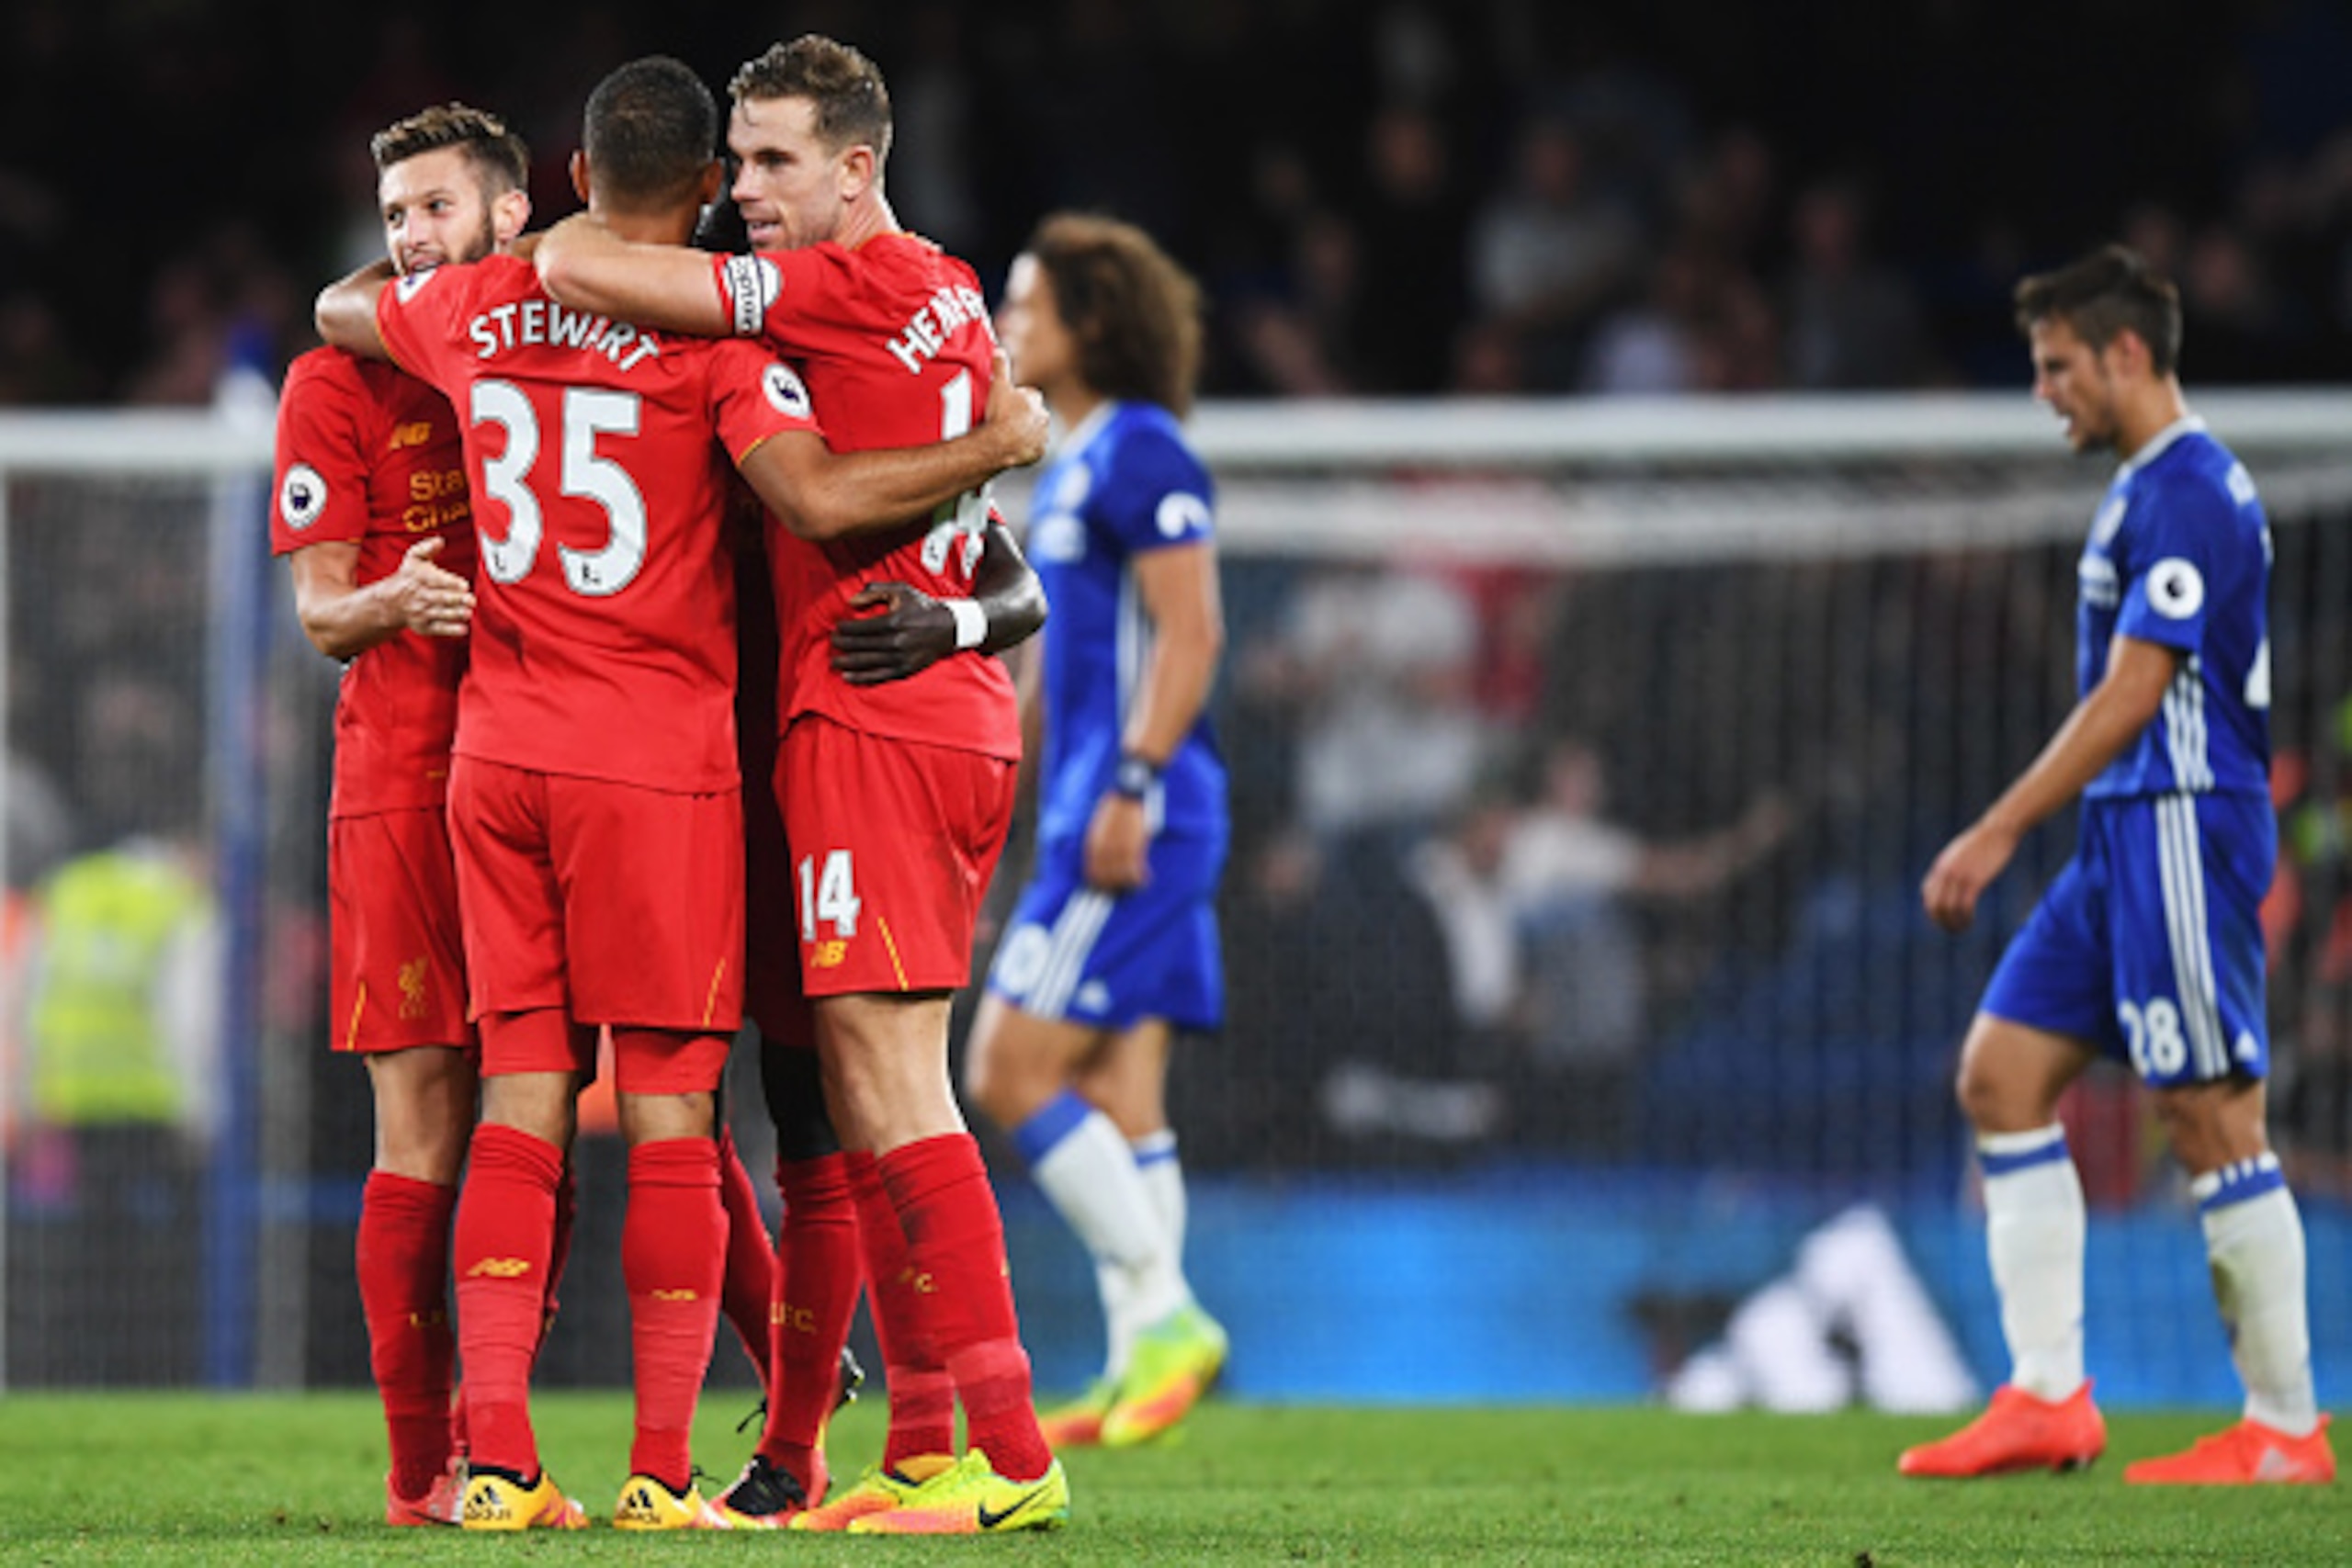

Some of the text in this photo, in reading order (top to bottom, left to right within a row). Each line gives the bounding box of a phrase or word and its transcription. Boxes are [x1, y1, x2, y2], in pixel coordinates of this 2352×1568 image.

[469, 299, 660, 372] STEWART
[470, 378, 646, 595] 35
[798, 849, 861, 941] 14
[2117, 996, 2188, 1077] 28
